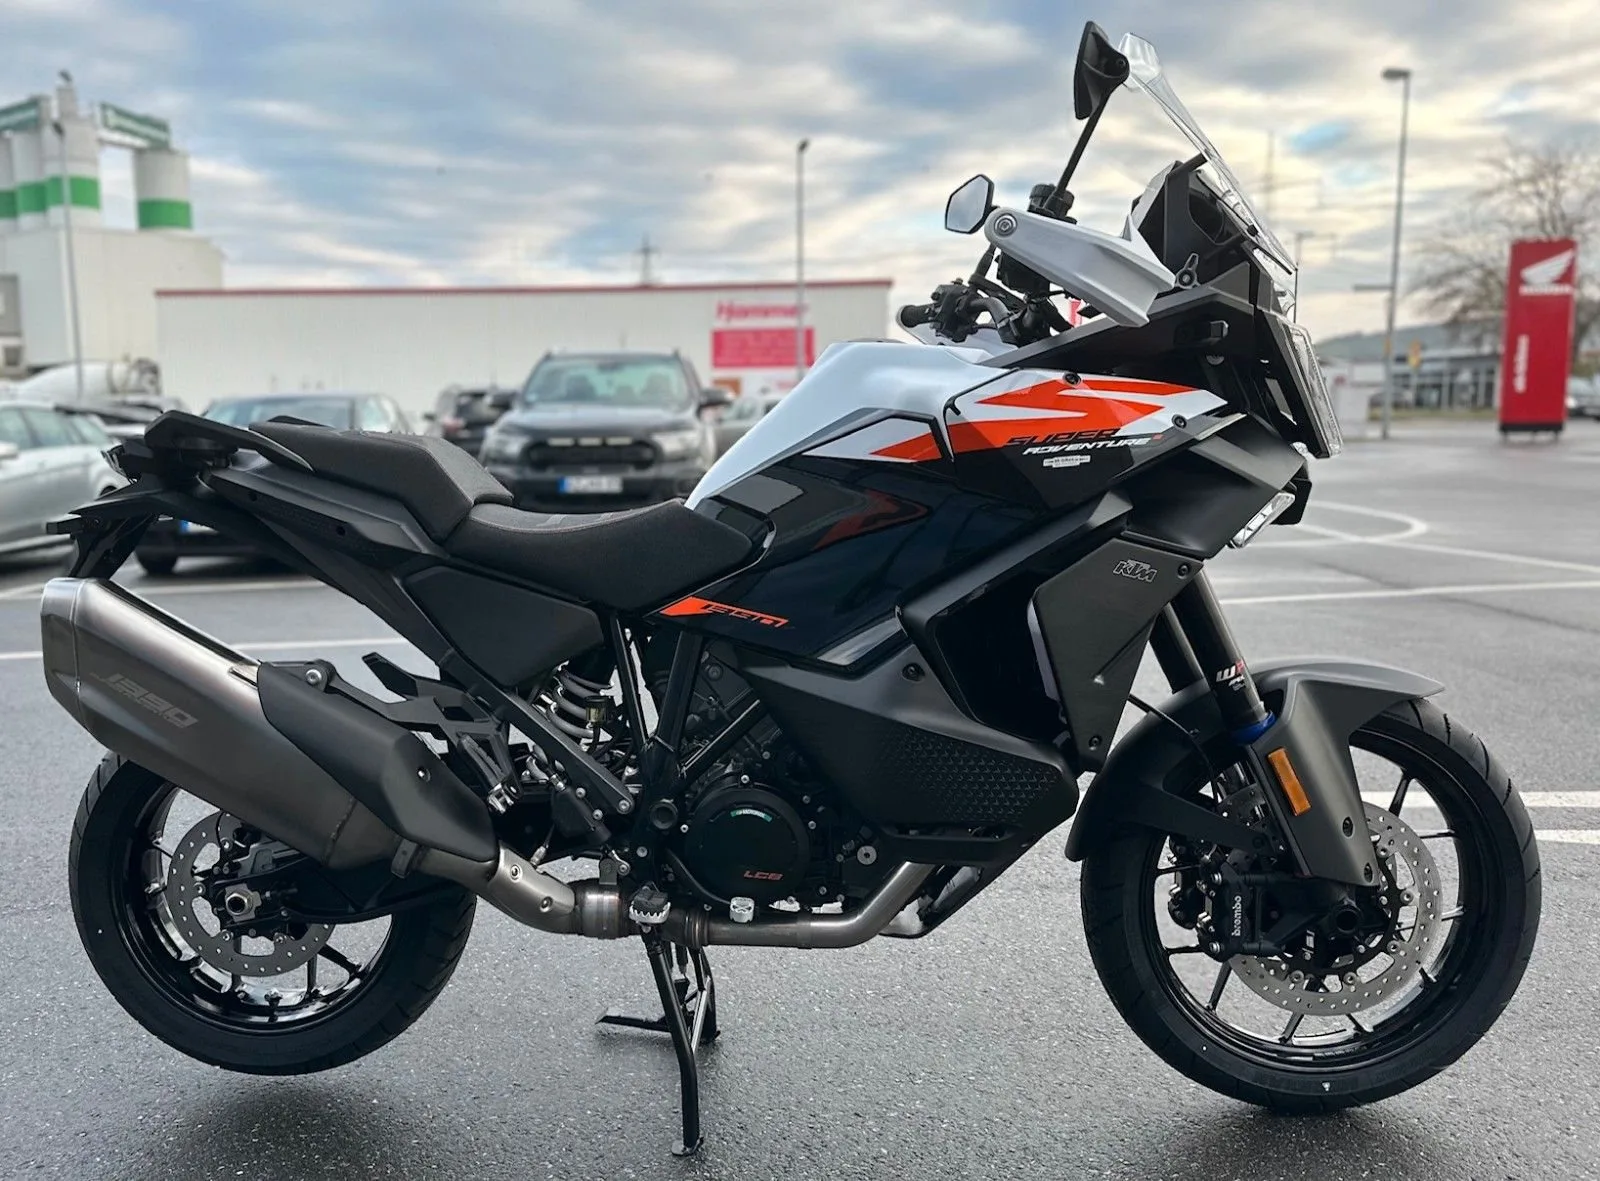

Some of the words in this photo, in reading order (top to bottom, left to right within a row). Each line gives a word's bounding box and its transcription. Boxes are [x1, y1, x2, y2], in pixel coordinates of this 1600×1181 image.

[1022, 437, 1151, 456] ADVENTURE
[1112, 559, 1158, 582] KTM
[1231, 895, 1242, 937] brembo
